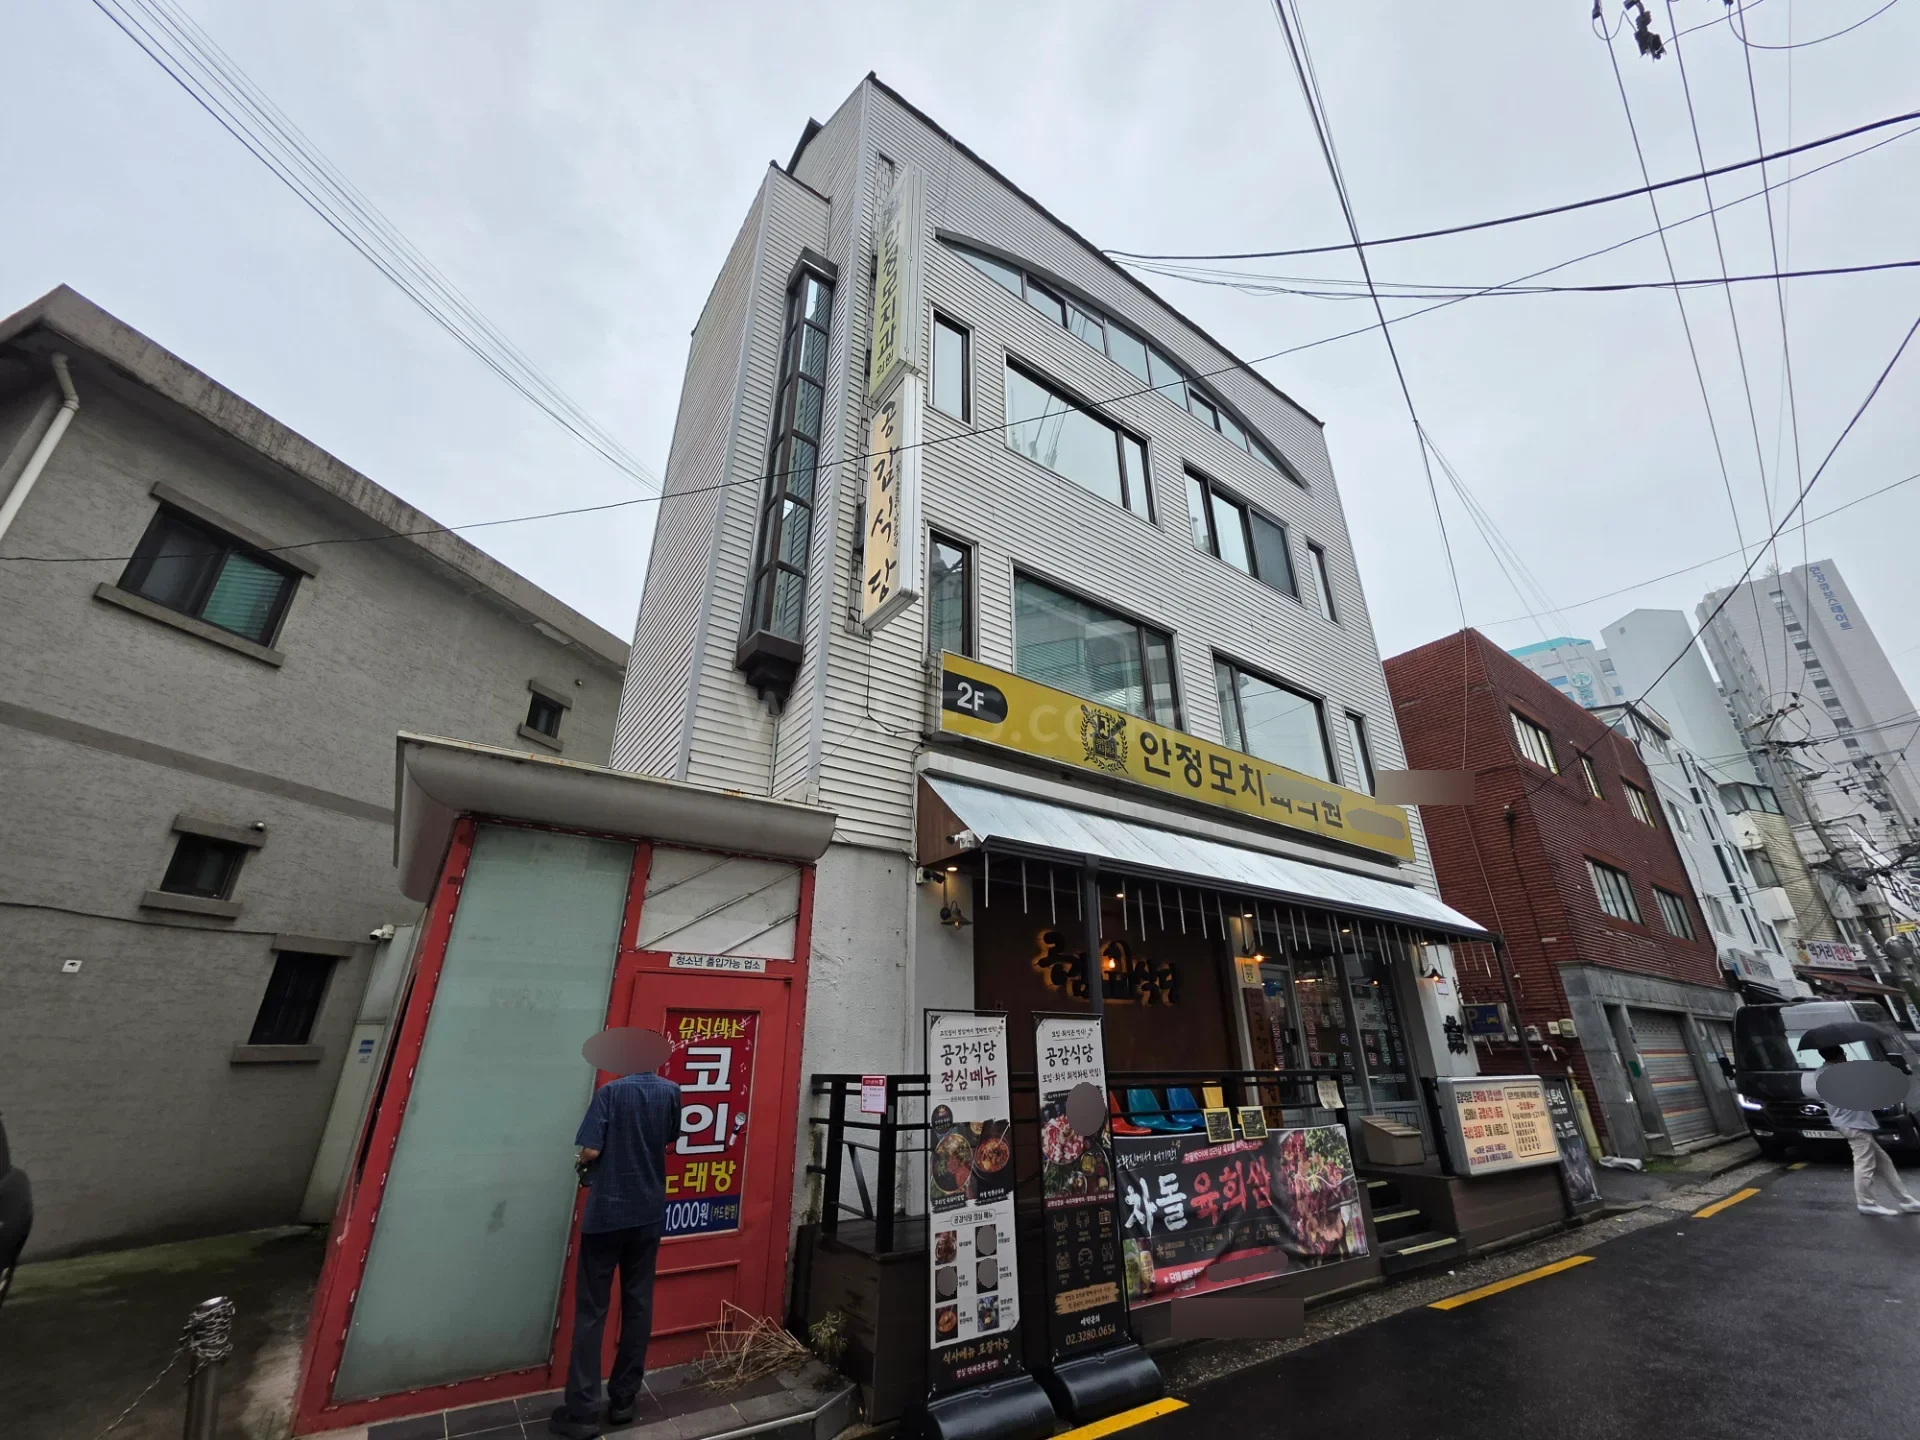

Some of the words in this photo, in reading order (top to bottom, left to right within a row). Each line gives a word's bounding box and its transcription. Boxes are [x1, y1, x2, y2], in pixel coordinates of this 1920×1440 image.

[867, 400, 900, 604] 공감식당
[957, 682, 985, 711] 2F
[1140, 731, 1343, 829] 안정모치원
[675, 955, 703, 967] 청소년
[705, 956, 742, 969] 출입가능
[744, 958, 761, 970] 업소
[678, 1016, 746, 1040] 뮤직박스
[941, 1040, 997, 1067] 공감식당
[1045, 1043, 1094, 1068] 공감식당
[941, 1066, 998, 1093] 점심메뉴
[978, 1337, 1010, 1356] 포장가능
